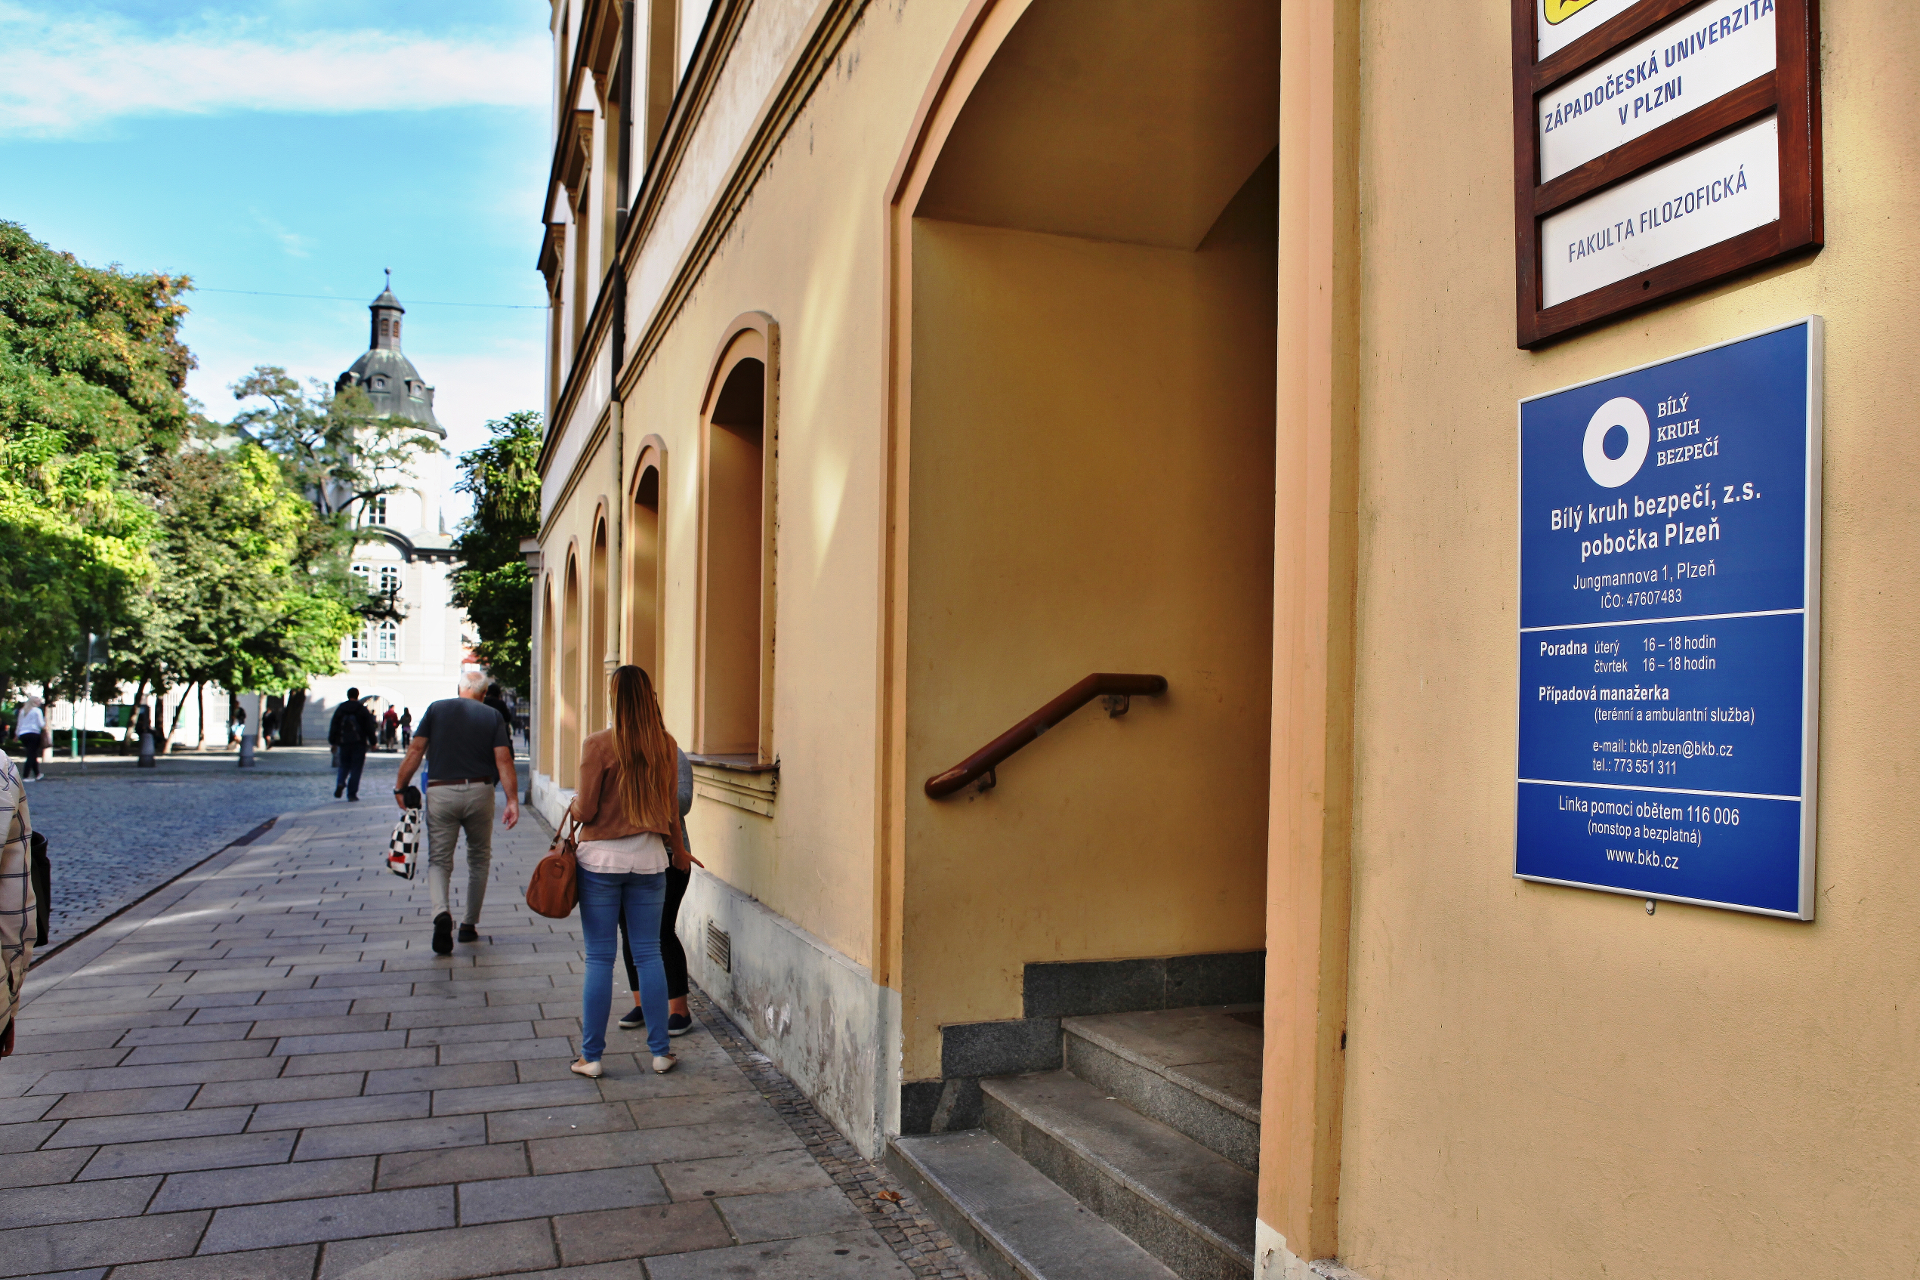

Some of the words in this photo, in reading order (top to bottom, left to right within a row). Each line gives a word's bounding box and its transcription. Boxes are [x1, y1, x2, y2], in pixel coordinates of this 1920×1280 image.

[1545, 49, 1659, 134] ZÁPADOČESKÁ
[1664, 0, 1774, 68] UNIVERZITA
[1618, 103, 1629, 126] V
[1633, 75, 1683, 119] PLZNI
[1568, 218, 1634, 263] FAKULTA
[1639, 164, 1748, 233] FILOZOFICKÁ
[1657, 392, 1689, 418] BÍLÝ
[1657, 419, 1700, 442] KRUH
[1656, 435, 1719, 467] BEZPEČÍ
[1551, 504, 1583, 533] Bílý
[1588, 498, 1628, 525] kruh
[1634, 482, 1716, 518] bezpečí,
[1723, 481, 1761, 504] z.s.
[1581, 529, 1658, 563] pobočka
[1665, 516, 1720, 547] Plzeň
[1573, 567, 1658, 591] Jungmannova
[1662, 565, 1673, 583] 1,
[1677, 559, 1716, 580] Plzeň
[1601, 591, 1624, 609] IČO:
[1626, 588, 1682, 606] 47607483
[1540, 640, 1588, 656] Poradna
[1594, 639, 1620, 657] úterý
[1643, 637, 1656, 652] 16
[1668, 636, 1682, 650] 18
[1684, 635, 1716, 650] hodin
[1594, 658, 1628, 673] čtvrtek
[1642, 658, 1655, 672] 16
[1668, 657, 1682, 671] 18
[1684, 656, 1716, 670] hodin
[1539, 685, 1597, 704] Případová
[1600, 685, 1669, 701] manažerka
[1594, 707, 1634, 723] (terénní
[1636, 711, 1642, 721] a
[1646, 707, 1707, 722] ambulantní
[1710, 707, 1755, 724] služba)
[1593, 739, 1627, 753] e-mail:
[1629, 740, 1733, 758] bkb.plzen@bkb.cz
[1593, 759, 1611, 772] tel.:
[1614, 759, 1633, 772] 773
[1635, 760, 1655, 773] 551
[1657, 761, 1677, 775] 311
[1559, 795, 1588, 812] Linka
[1591, 801, 1633, 817] pomoci
[1636, 802, 1683, 821] obětem
[1687, 806, 1710, 823] 116
[1714, 808, 1740, 825] 006
[1588, 821, 1631, 839] (nonstop
[1634, 828, 1640, 838] a
[1643, 825, 1702, 847] bezplatná)
[1606, 847, 1679, 870] www.bkb.cz
